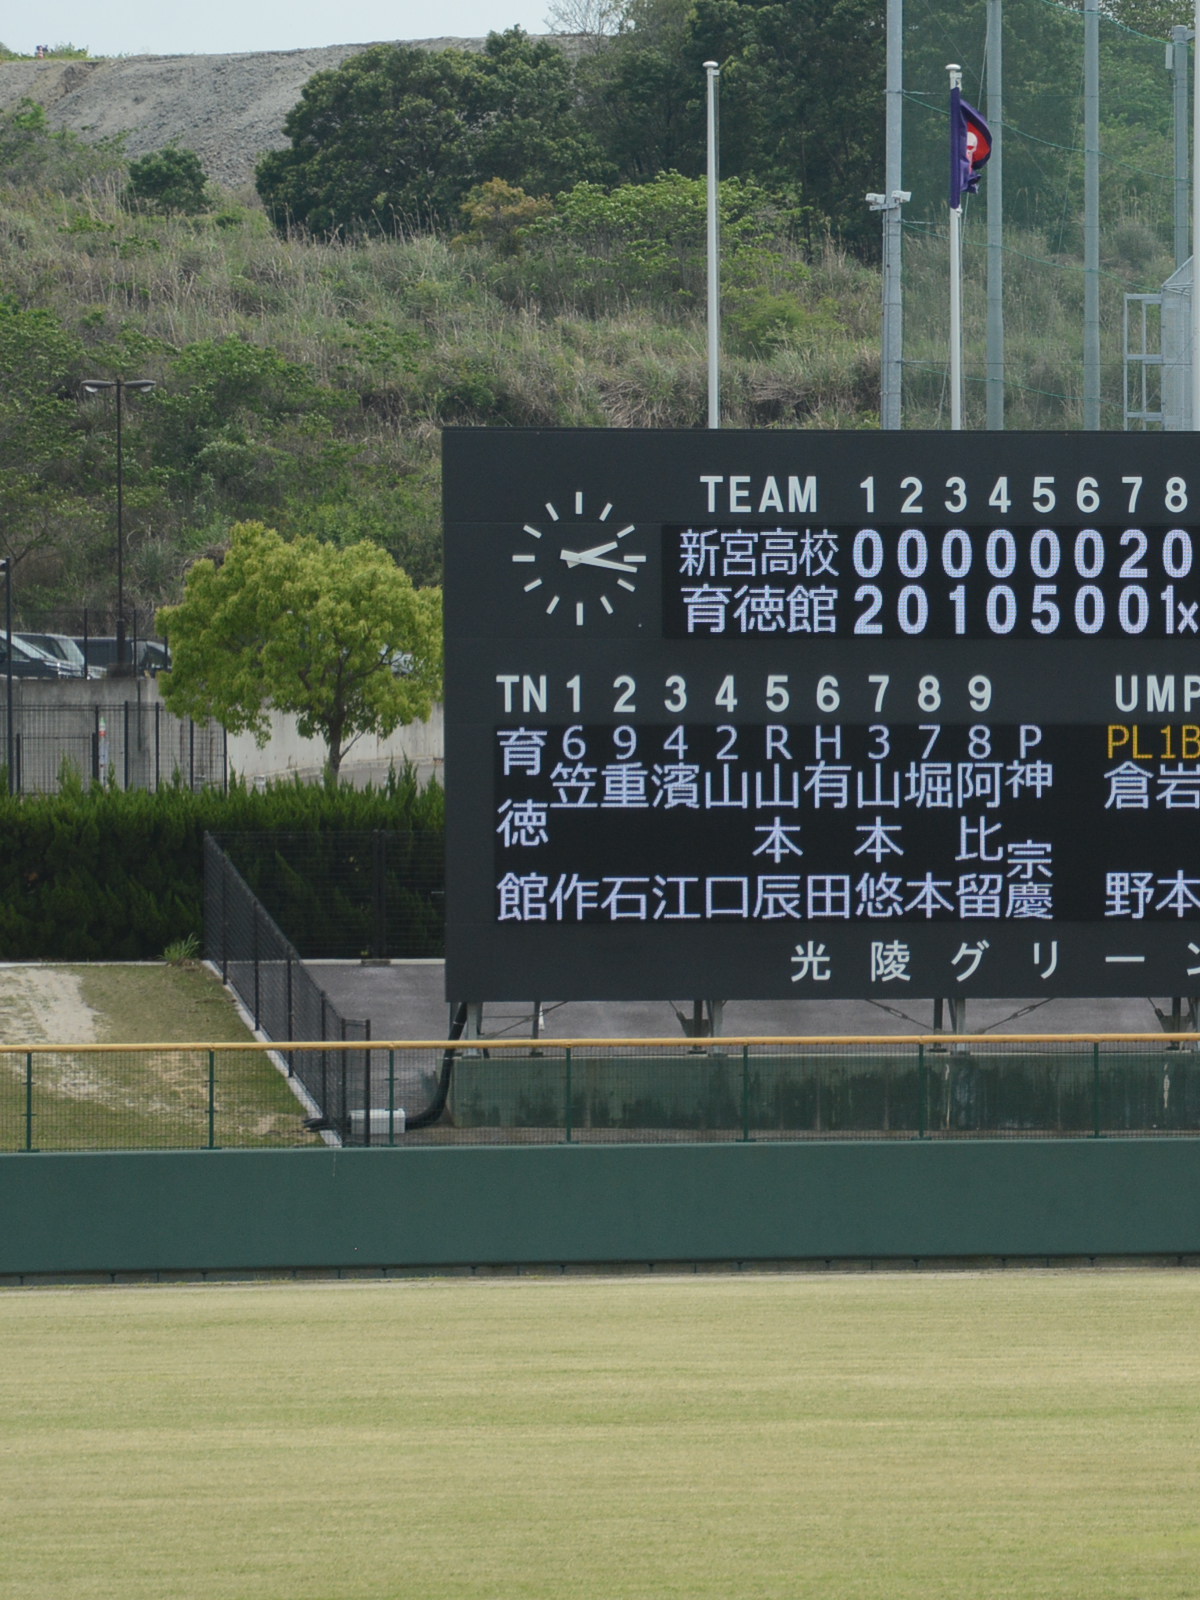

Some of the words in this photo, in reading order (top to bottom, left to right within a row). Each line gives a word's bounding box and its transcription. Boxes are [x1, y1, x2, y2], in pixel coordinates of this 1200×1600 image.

[679, 527, 839, 576] 新宮高校
[853, 529, 884, 578] 0
[897, 529, 928, 578] 0
[942, 529, 972, 578] 0
[986, 529, 1016, 578] 0
[1030, 529, 1061, 578] 0
[1074, 529, 1105, 578] 0
[1119, 529, 1148, 578] 2
[1162, 529, 1193, 578] 0
[700, 476, 817, 513] TEAM
[860, 476, 874, 513] 1
[900, 476, 923, 513] 2
[945, 476, 967, 513] 3
[989, 476, 1011, 513] 4
[1033, 476, 1056, 513] 5
[1077, 476, 1100, 513] 6
[1122, 476, 1142, 513] 7
[1165, 476, 1188, 513] 8
[681, 583, 838, 633] 育徳館
[854, 584, 883, 634] 2
[897, 584, 928, 634] 0
[949, 584, 966, 634] 1
[986, 584, 1017, 634] 0
[1031, 584, 1060, 634] 5
[1074, 584, 1105, 634] 0
[1118, 584, 1149, 634] 0
[496, 675, 547, 712] TN
[566, 675, 580, 712] 1
[613, 675, 636, 713] 2
[664, 675, 687, 712] 3
[715, 675, 738, 712] 4
[766, 675, 789, 712] 5
[816, 675, 840, 712] 6
[868, 675, 889, 712] 7
[918, 675, 941, 712] 8
[968, 675, 992, 712] 9
[563, 725, 586, 760] 6
[613, 725, 636, 760] 9
[664, 725, 688, 760] 4
[717, 725, 738, 760] 2
[766, 725, 792, 759] R
[816, 725, 841, 759] H
[868, 725, 890, 759] 3
[919, 724, 940, 759] 7
[968, 724, 991, 759] 8
[1020, 725, 1042, 759] P
[1108, 725, 1152, 758] PL
[496, 727, 548, 920] 育徳館
[549, 762, 599, 920] 笠作
[601, 762, 650, 920] 重石
[705, 763, 748, 918] 山口
[753, 763, 803, 919] 山本辰
[804, 760, 852, 919] 有田
[855, 763, 903, 917] 山本悠
[904, 761, 953, 918] 堀本
[955, 762, 1003, 918] 阿比留
[1104, 761, 1154, 919] 倉野
